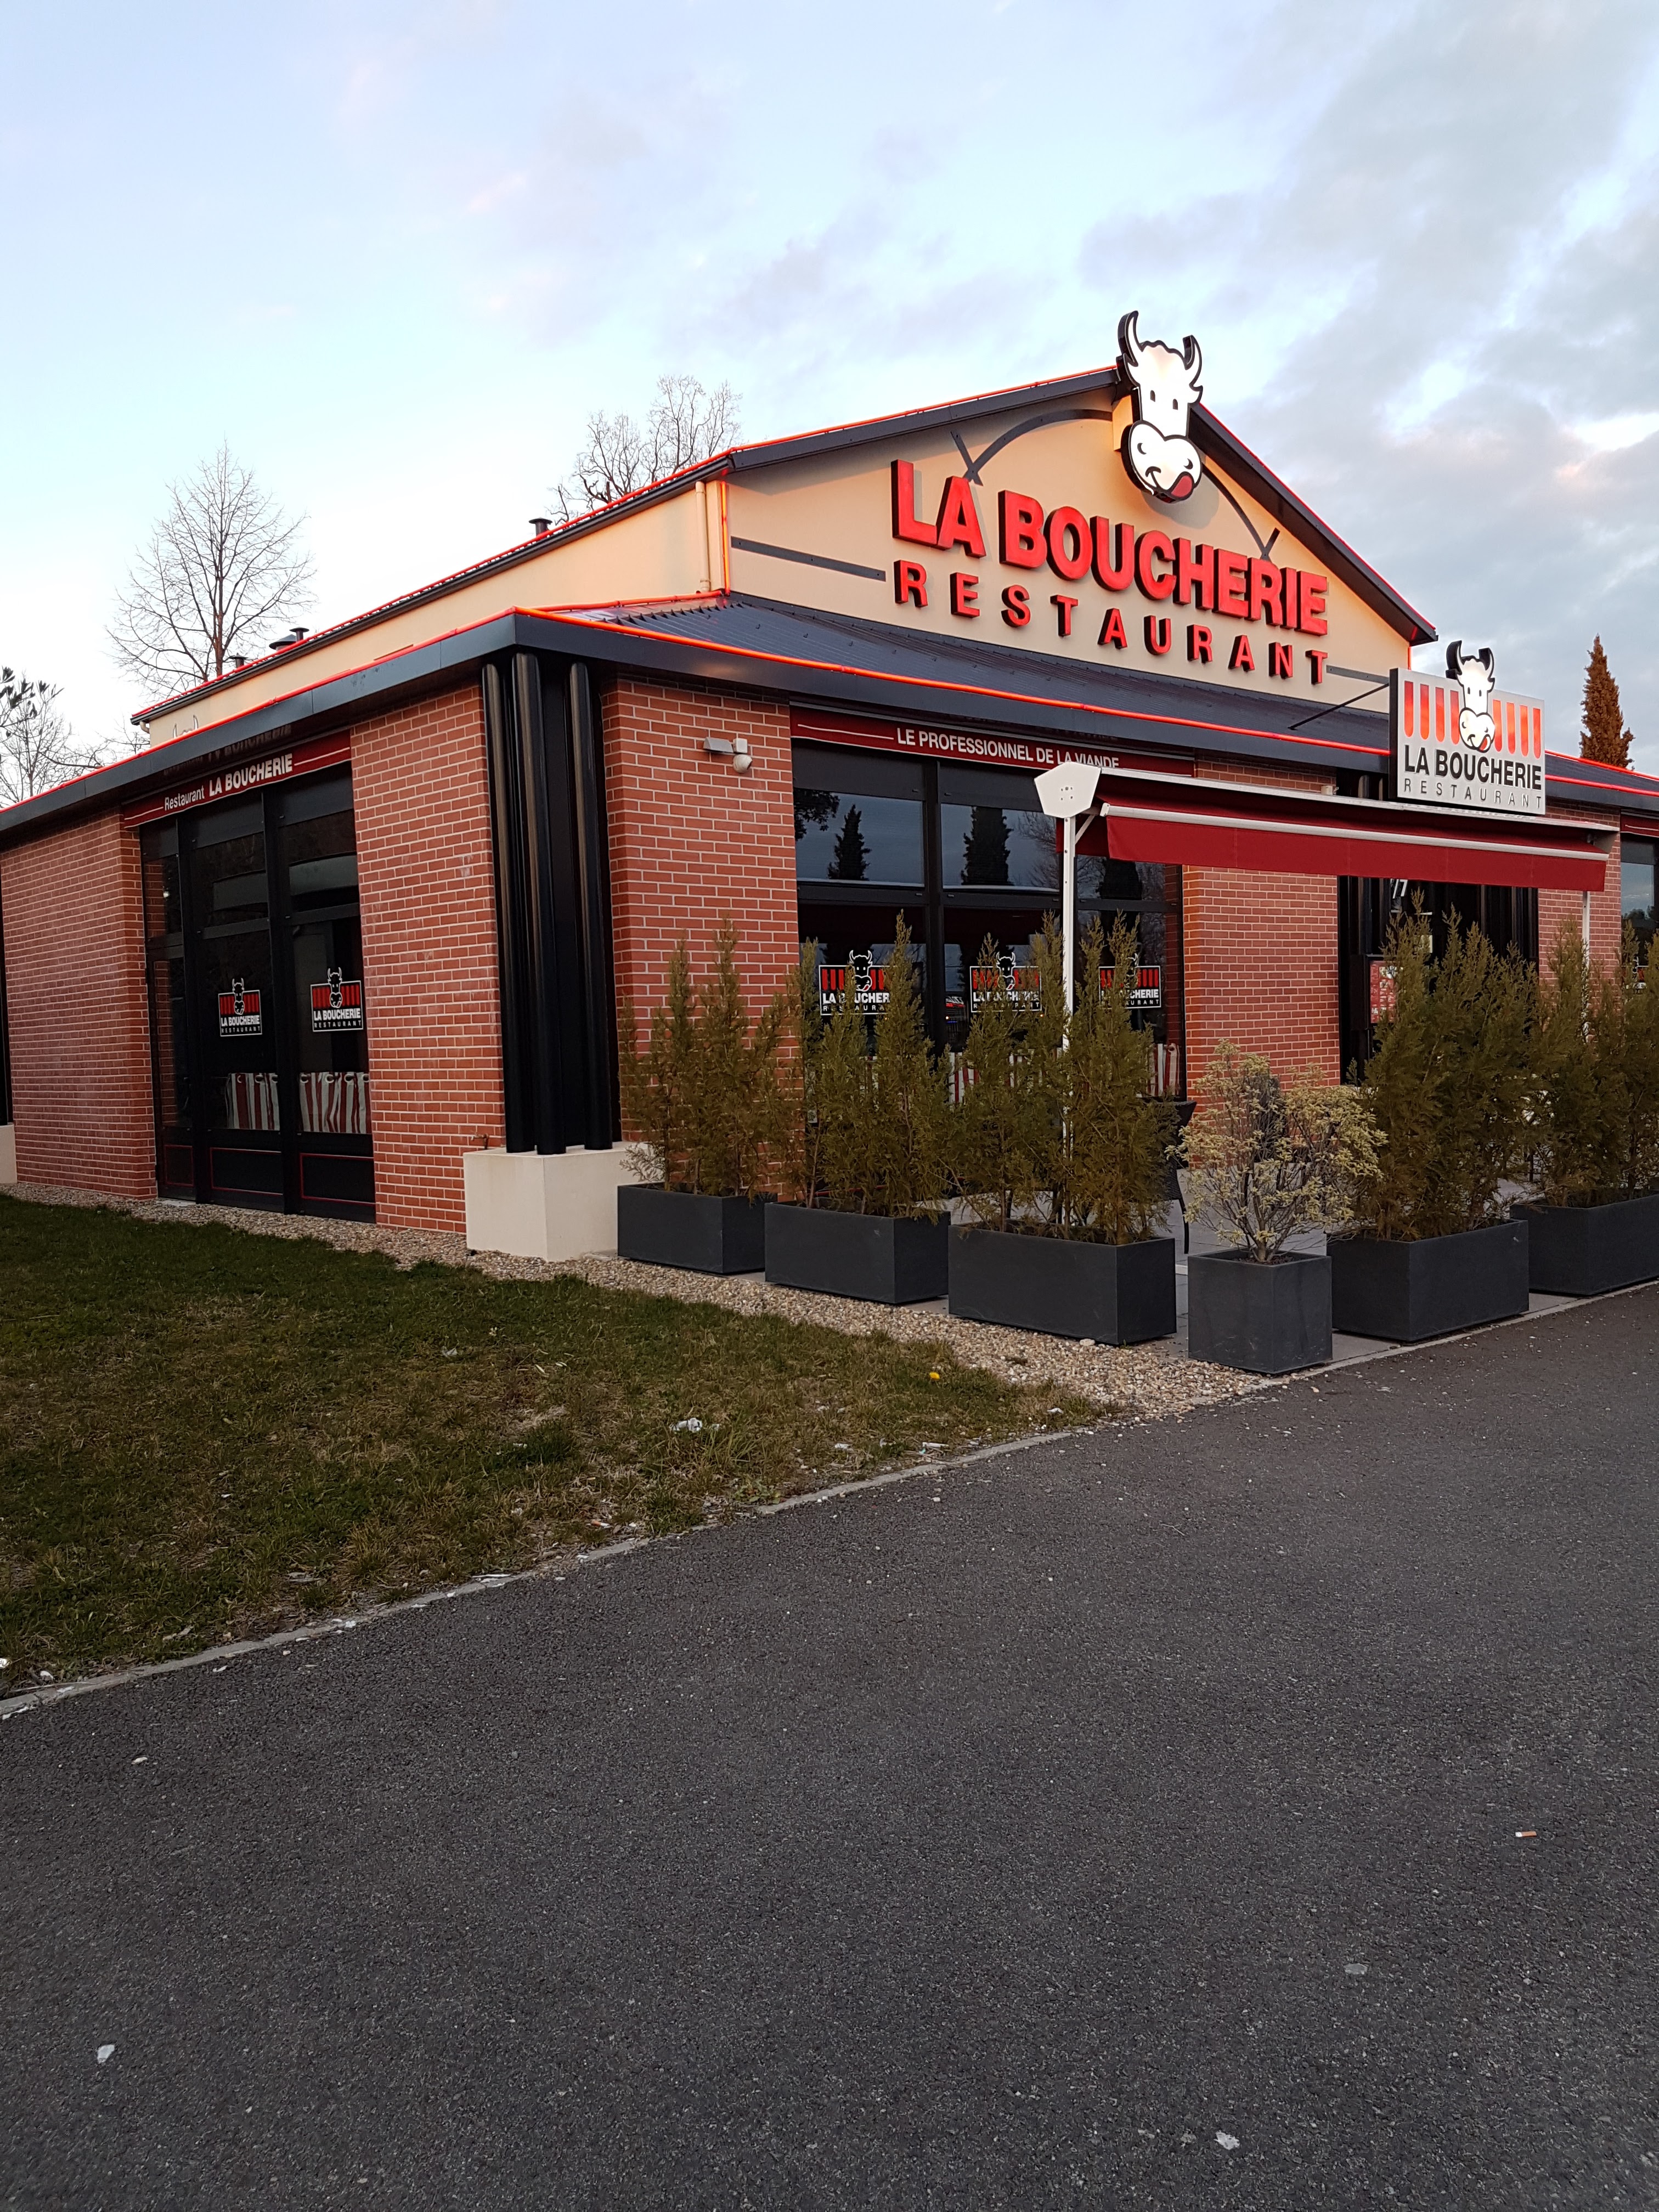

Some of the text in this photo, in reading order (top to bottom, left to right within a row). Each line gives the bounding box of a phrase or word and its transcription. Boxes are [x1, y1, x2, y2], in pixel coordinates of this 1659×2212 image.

[891, 459, 1328, 637] LA BOUCHERIE
[894, 560, 1329, 685] RESTAURANT
[897, 727, 916, 746] LE
[918, 730, 1034, 761] PROFESSIONNEL
[1036, 747, 1054, 764] DE
[1057, 750, 1072, 765] LA
[165, 787, 205, 811] Restaurant
[209, 779, 222, 797] LA
[225, 753, 293, 791] BOUCHERIE
[1404, 744, 1542, 791] LA BOUCHERIE
[1403, 778, 1542, 809] RESTAURANT
[822, 992, 837, 1005] LA
[221, 1015, 260, 1027] LA BOUCHERIE
[221, 1025, 261, 1034] RESTAURANT
[313, 1008, 361, 1021] LA BOUCHERIE
[314, 1020, 362, 1029] RESTAURANT
